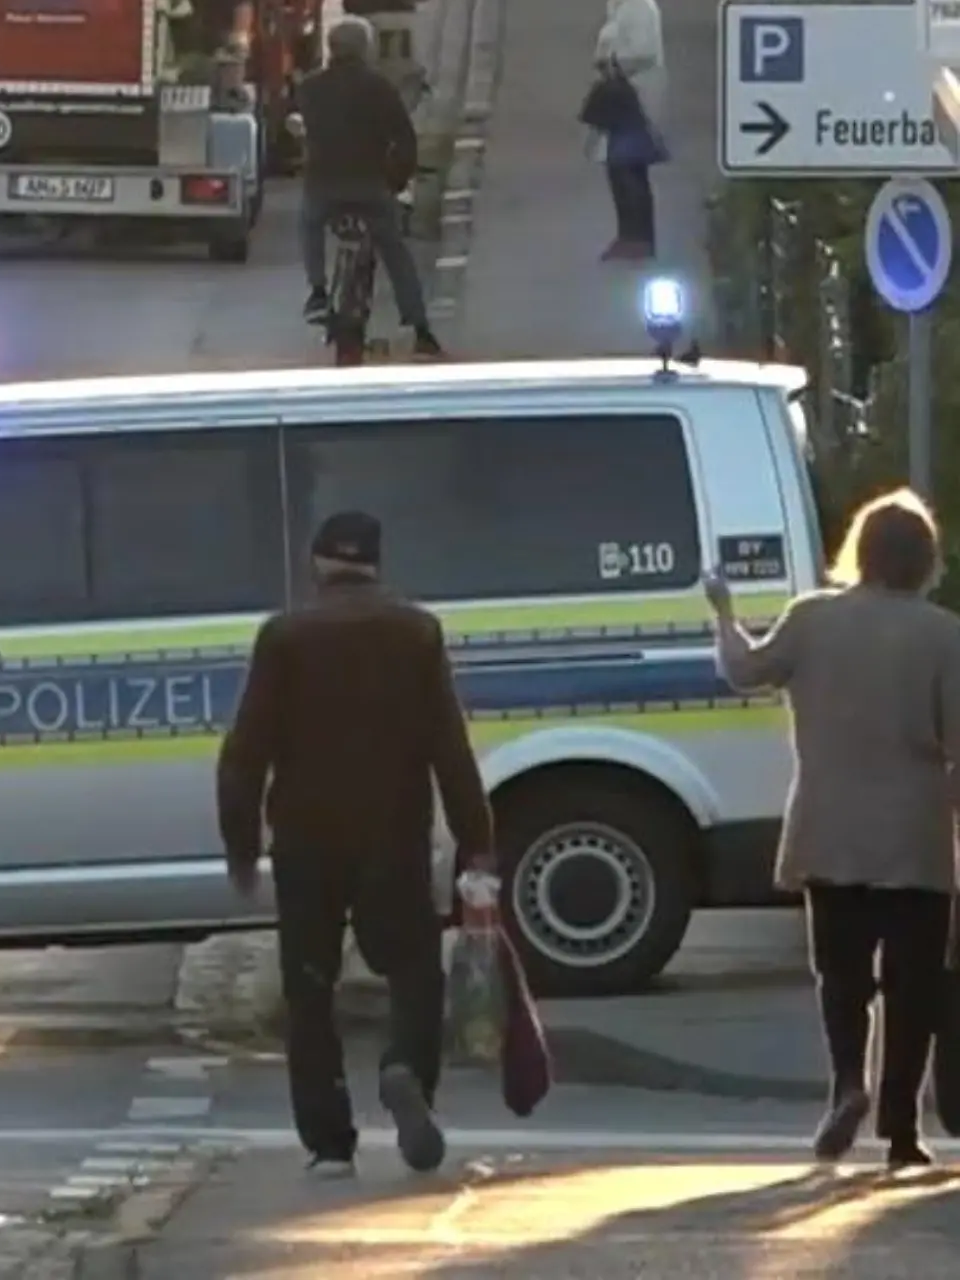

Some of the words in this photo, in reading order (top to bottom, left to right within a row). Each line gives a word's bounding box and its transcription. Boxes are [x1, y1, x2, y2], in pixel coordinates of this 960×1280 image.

[753, 24, 789, 76] P
[815, 108, 936, 146] Feuerba
[628, 543, 674, 574] 110
